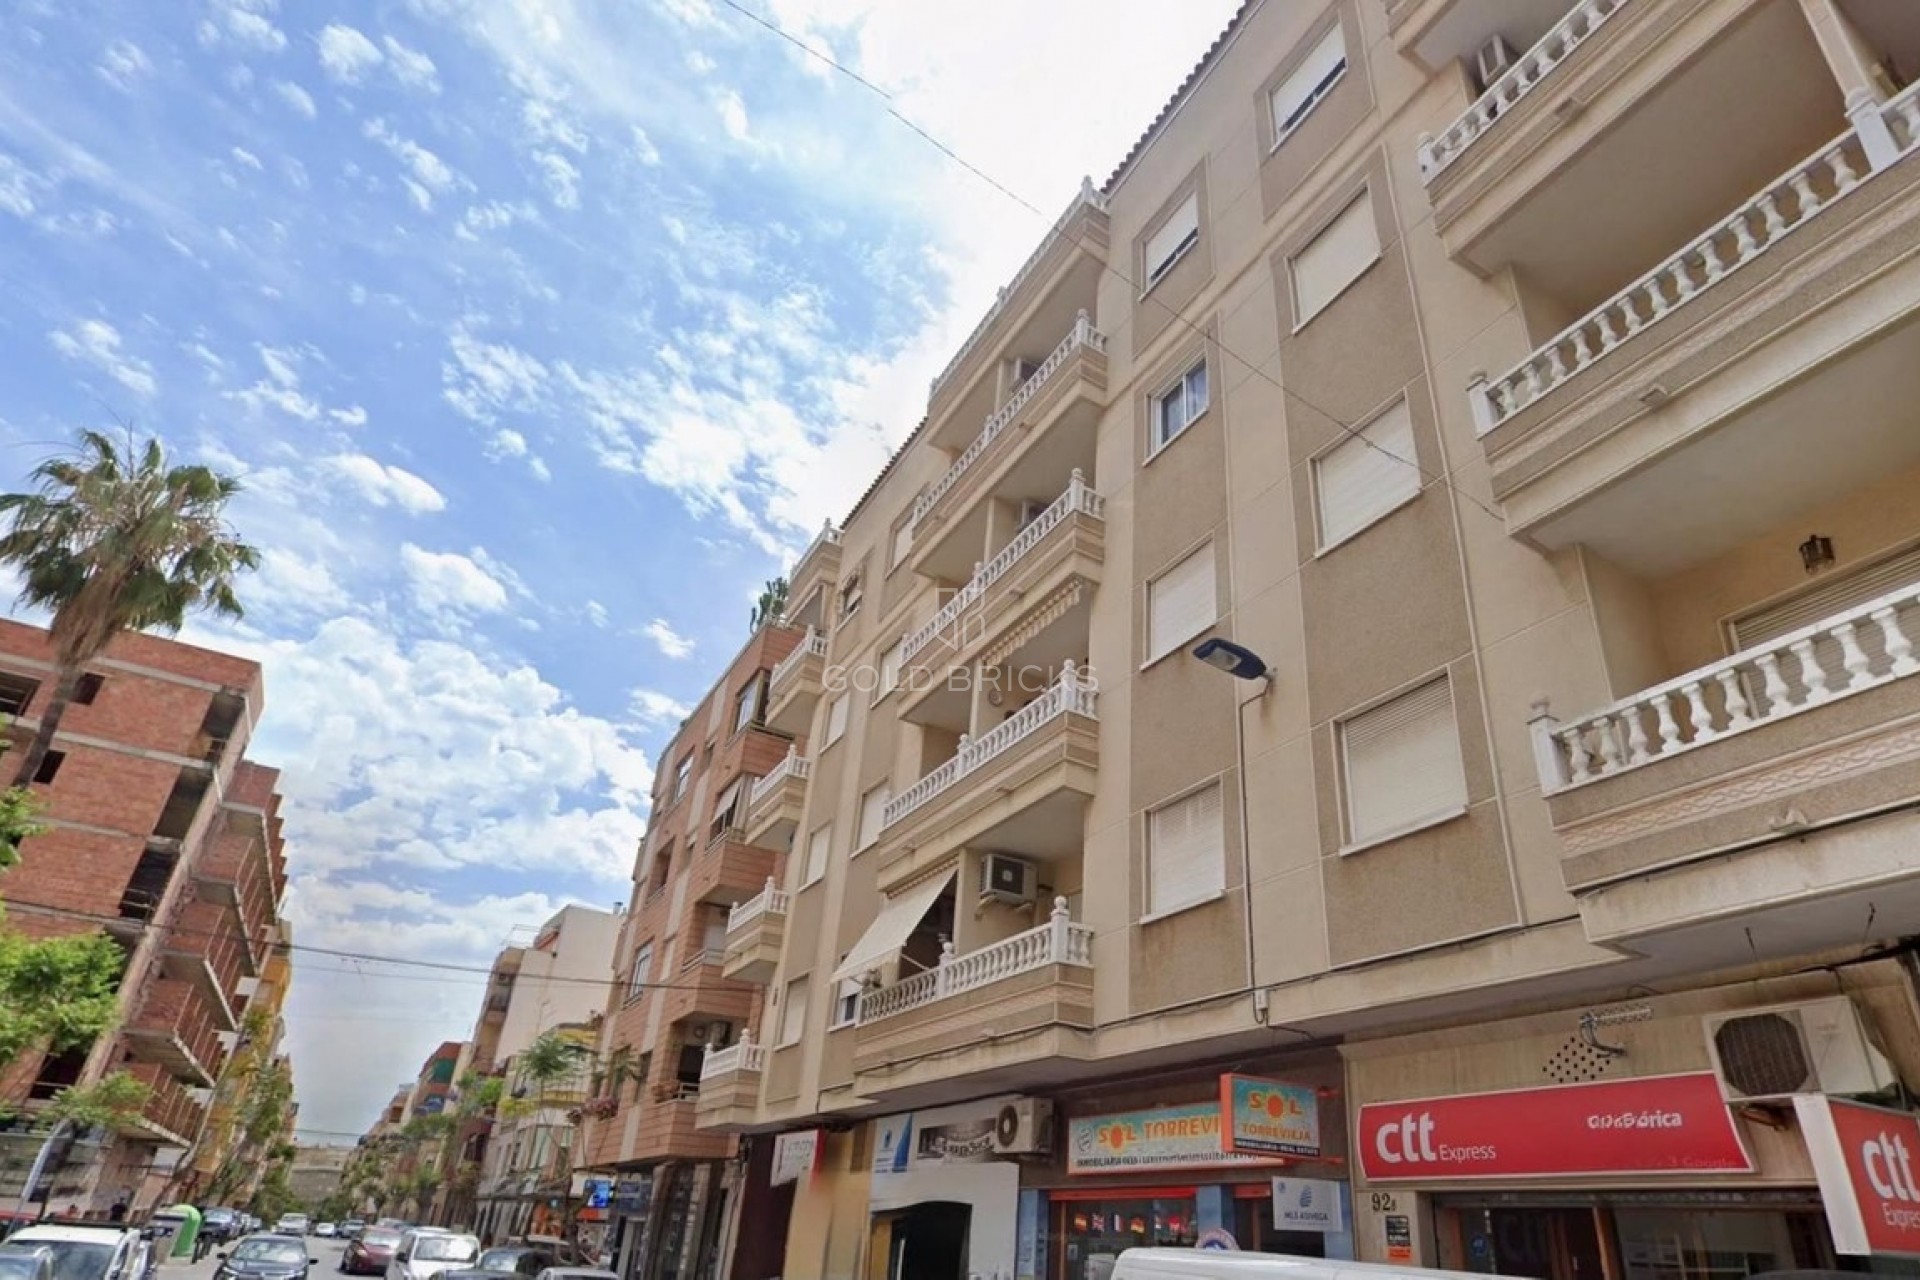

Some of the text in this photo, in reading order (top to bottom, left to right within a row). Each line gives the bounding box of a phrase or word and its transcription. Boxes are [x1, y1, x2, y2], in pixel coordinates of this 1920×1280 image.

[1249, 1092, 1303, 1118] SOL
[1098, 1123, 1138, 1149] SOL
[1376, 1112, 1436, 1163] ctt
[1439, 1144, 1497, 1164] Express
[1862, 1130, 1920, 1202] ctt
